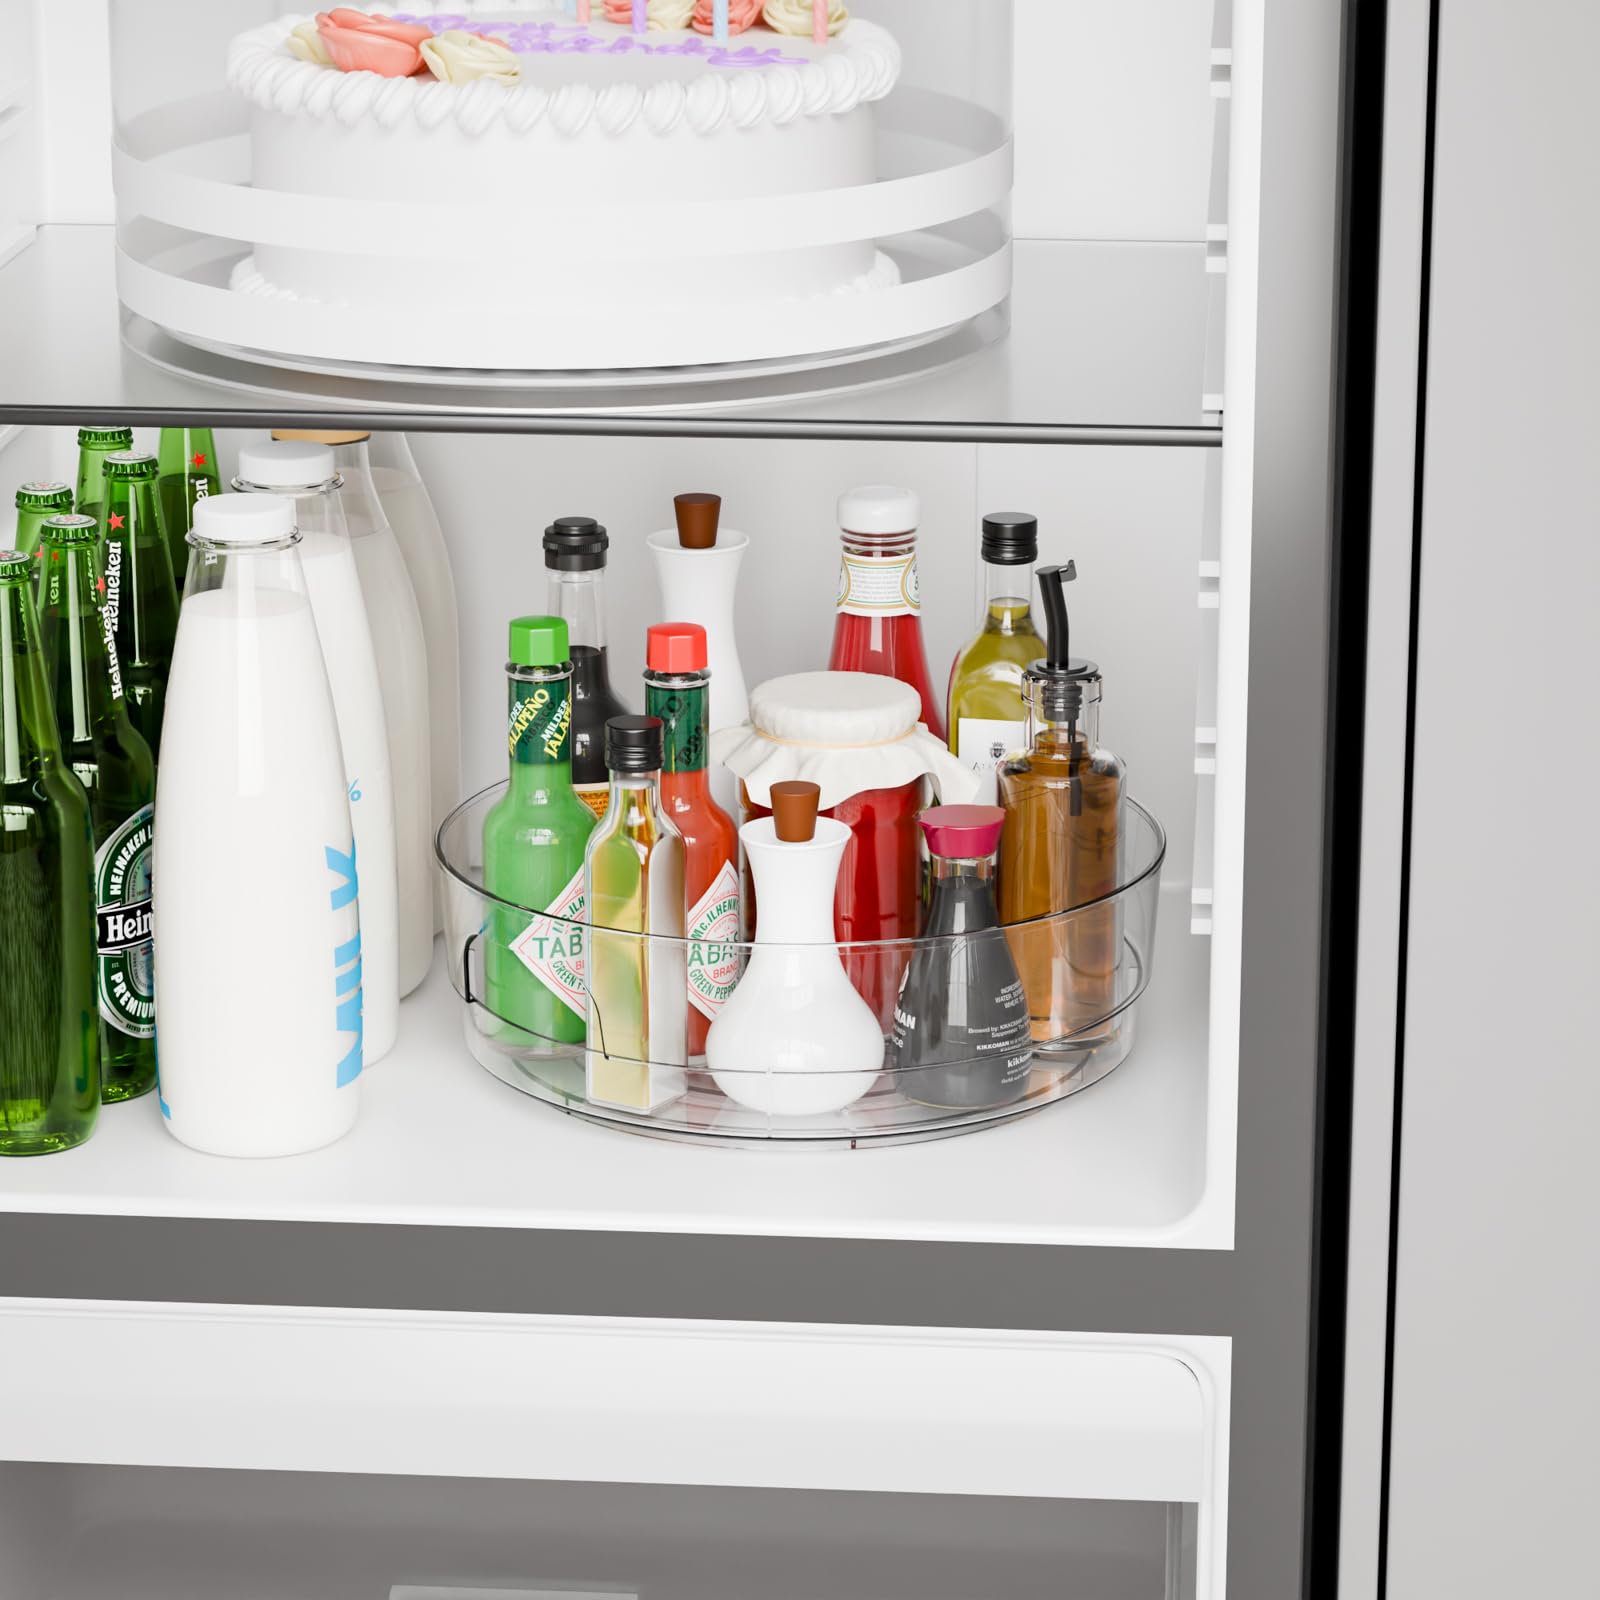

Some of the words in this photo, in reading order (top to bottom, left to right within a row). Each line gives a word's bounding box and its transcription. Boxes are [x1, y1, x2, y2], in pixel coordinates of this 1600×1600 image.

[541, 700, 568, 742] MILDER
[110, 828, 147, 896] HEINEKEN
[552, 960, 577, 988] GREEN
[689, 969, 714, 996] GREEN
[976, 1040, 1009, 1050] KIKKOMAN
